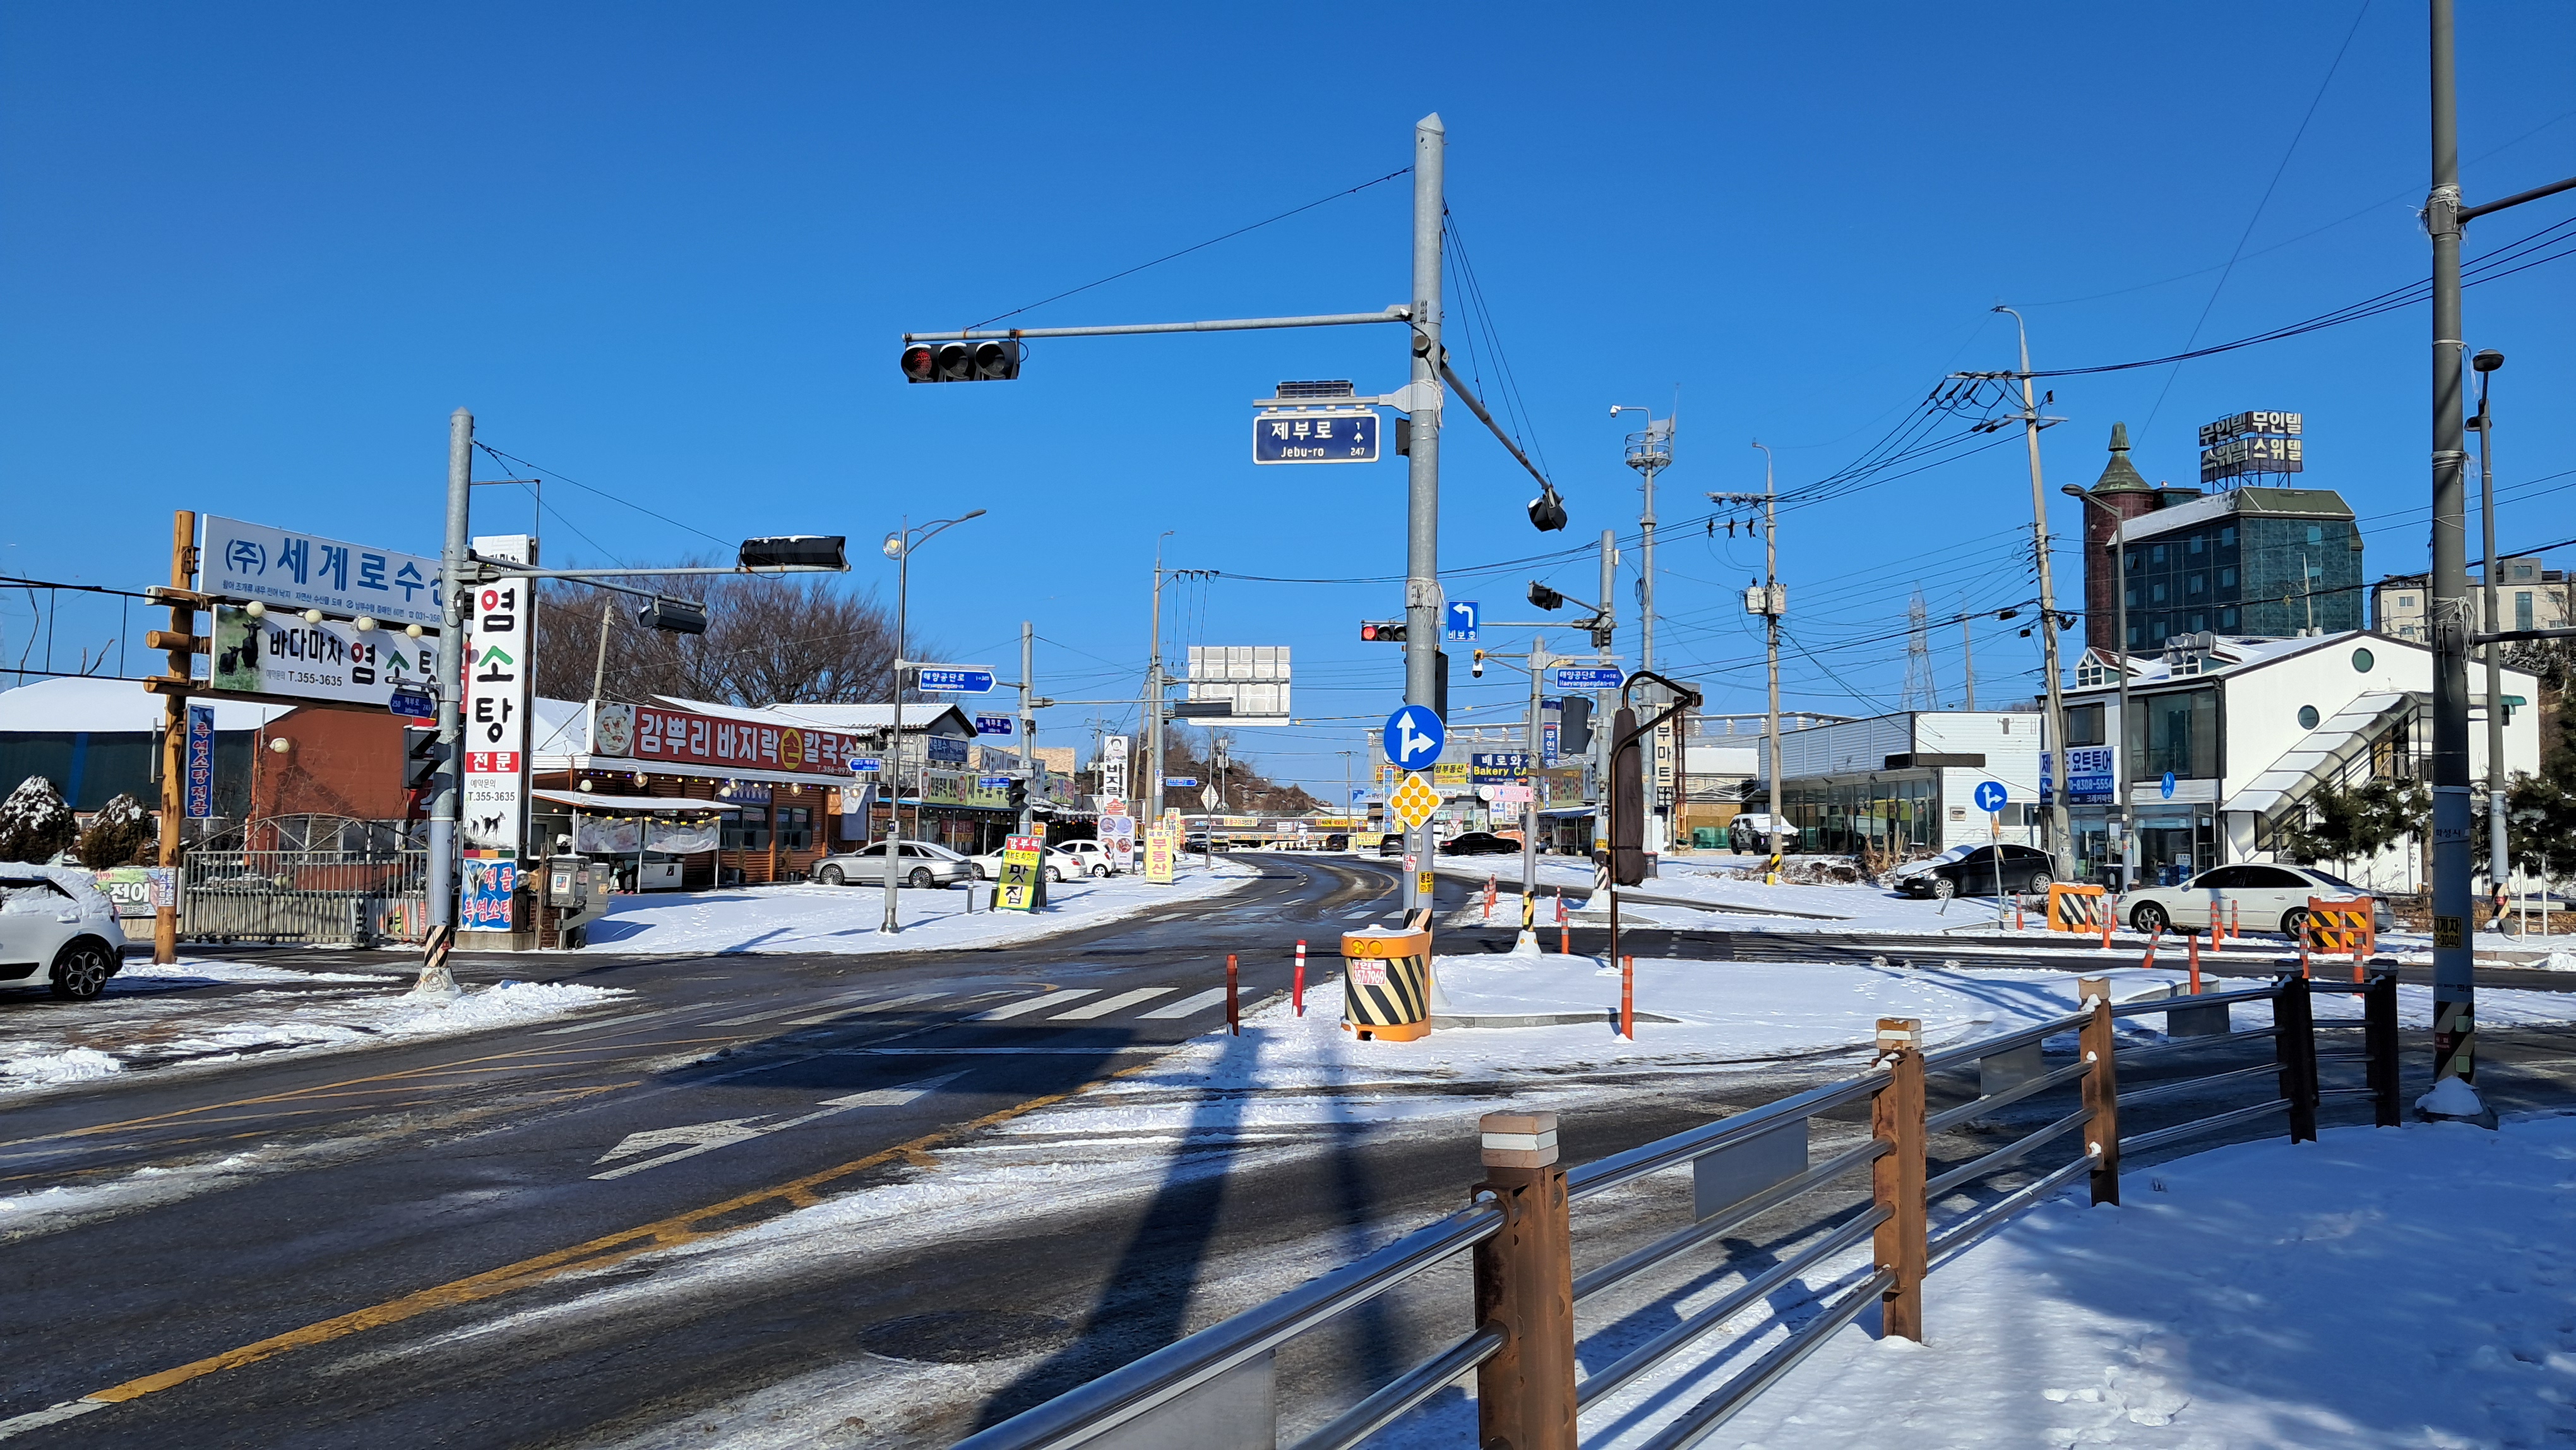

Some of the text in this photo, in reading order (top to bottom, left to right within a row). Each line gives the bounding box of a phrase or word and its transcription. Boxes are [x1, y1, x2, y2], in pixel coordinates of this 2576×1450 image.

[1271, 421, 1360, 440] 제부로 1
[2200, 412, 2246, 444] 무인텔
[2253, 412, 2301, 434] 무인텔
[1280, 446, 1365, 458] Jebu-ro 247
[2202, 439, 2248, 470] 스위텔
[2253, 438, 2301, 460] 스위텔
[225, 539, 266, 576] (주)
[1448, 630, 1476, 640] 비보호
[270, 628, 343, 666] 바다마차
[476, 587, 515, 743] 염소탕
[1559, 671, 1596, 680] 해양공단로
[288, 670, 342, 686] T.355-3635
[640, 713, 710, 758] 감뿌리
[717, 722, 779, 764] 바지락
[804, 731, 857, 765] 칼국수
[1657, 706, 1671, 782] 제부마트
[473, 753, 511, 770] 전문
[1474, 766, 1509, 776] Bakery
[1481, 754, 1528, 767] 배로와
[2072, 750, 2112, 772] 요트투어
[1106, 763, 1124, 798] 바지락
[2068, 778, 2113, 791] 0-8308-5554
[468, 792, 515, 801] T.355-3635
[1005, 851, 1020, 861] 제부도
[1152, 839, 1167, 875] 부동산
[484, 867, 515, 892] 전골
[1006, 864, 1029, 904] 맛집
[109, 882, 151, 903] 전어
